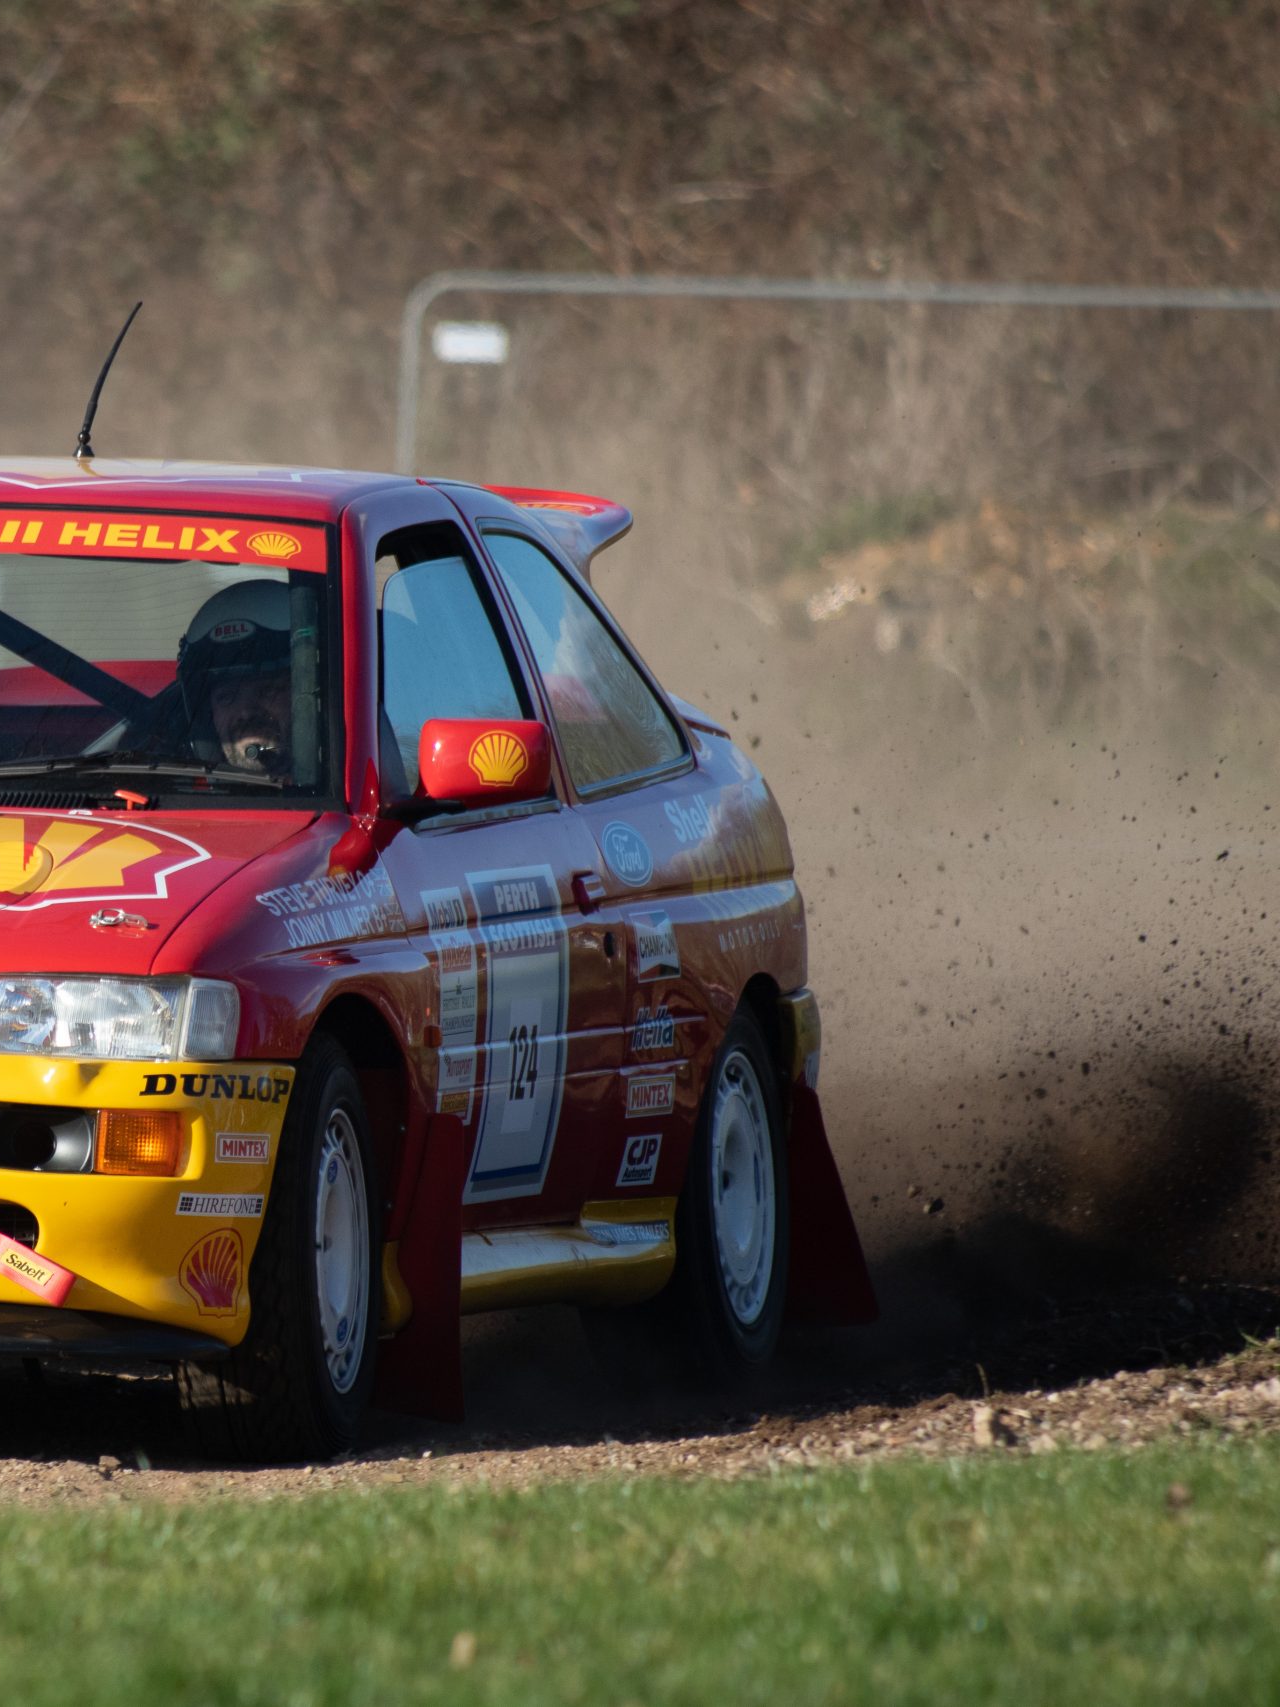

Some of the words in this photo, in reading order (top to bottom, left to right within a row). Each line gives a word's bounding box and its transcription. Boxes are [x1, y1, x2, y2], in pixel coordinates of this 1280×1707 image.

[58, 522, 241, 554] HELIX
[215, 623, 248, 637] BELL
[663, 794, 718, 843] Shell
[612, 833, 645, 873] Ford
[255, 882, 316, 916] STEVE
[304, 870, 361, 906] TURVEY
[493, 882, 540, 913] PERTH
[283, 912, 332, 948] JONNY
[327, 904, 376, 939] MILNER
[427, 900, 455, 930] Mobil
[488, 919, 556, 953] SCOTTISH
[631, 1005, 673, 1050] Hella
[509, 1024, 539, 1101] 124
[141, 1073, 291, 1104] DUNLOP
[631, 1083, 671, 1108] MINTEX
[222, 1139, 266, 1157] MINTEX
[627, 1138, 659, 1166] CJP
[623, 1165, 653, 1178] Autosport
[192, 1197, 257, 1215] HIREFONE
[635, 1222, 670, 1241] TRAILERS
[6, 1253, 45, 1281] Sabelt
